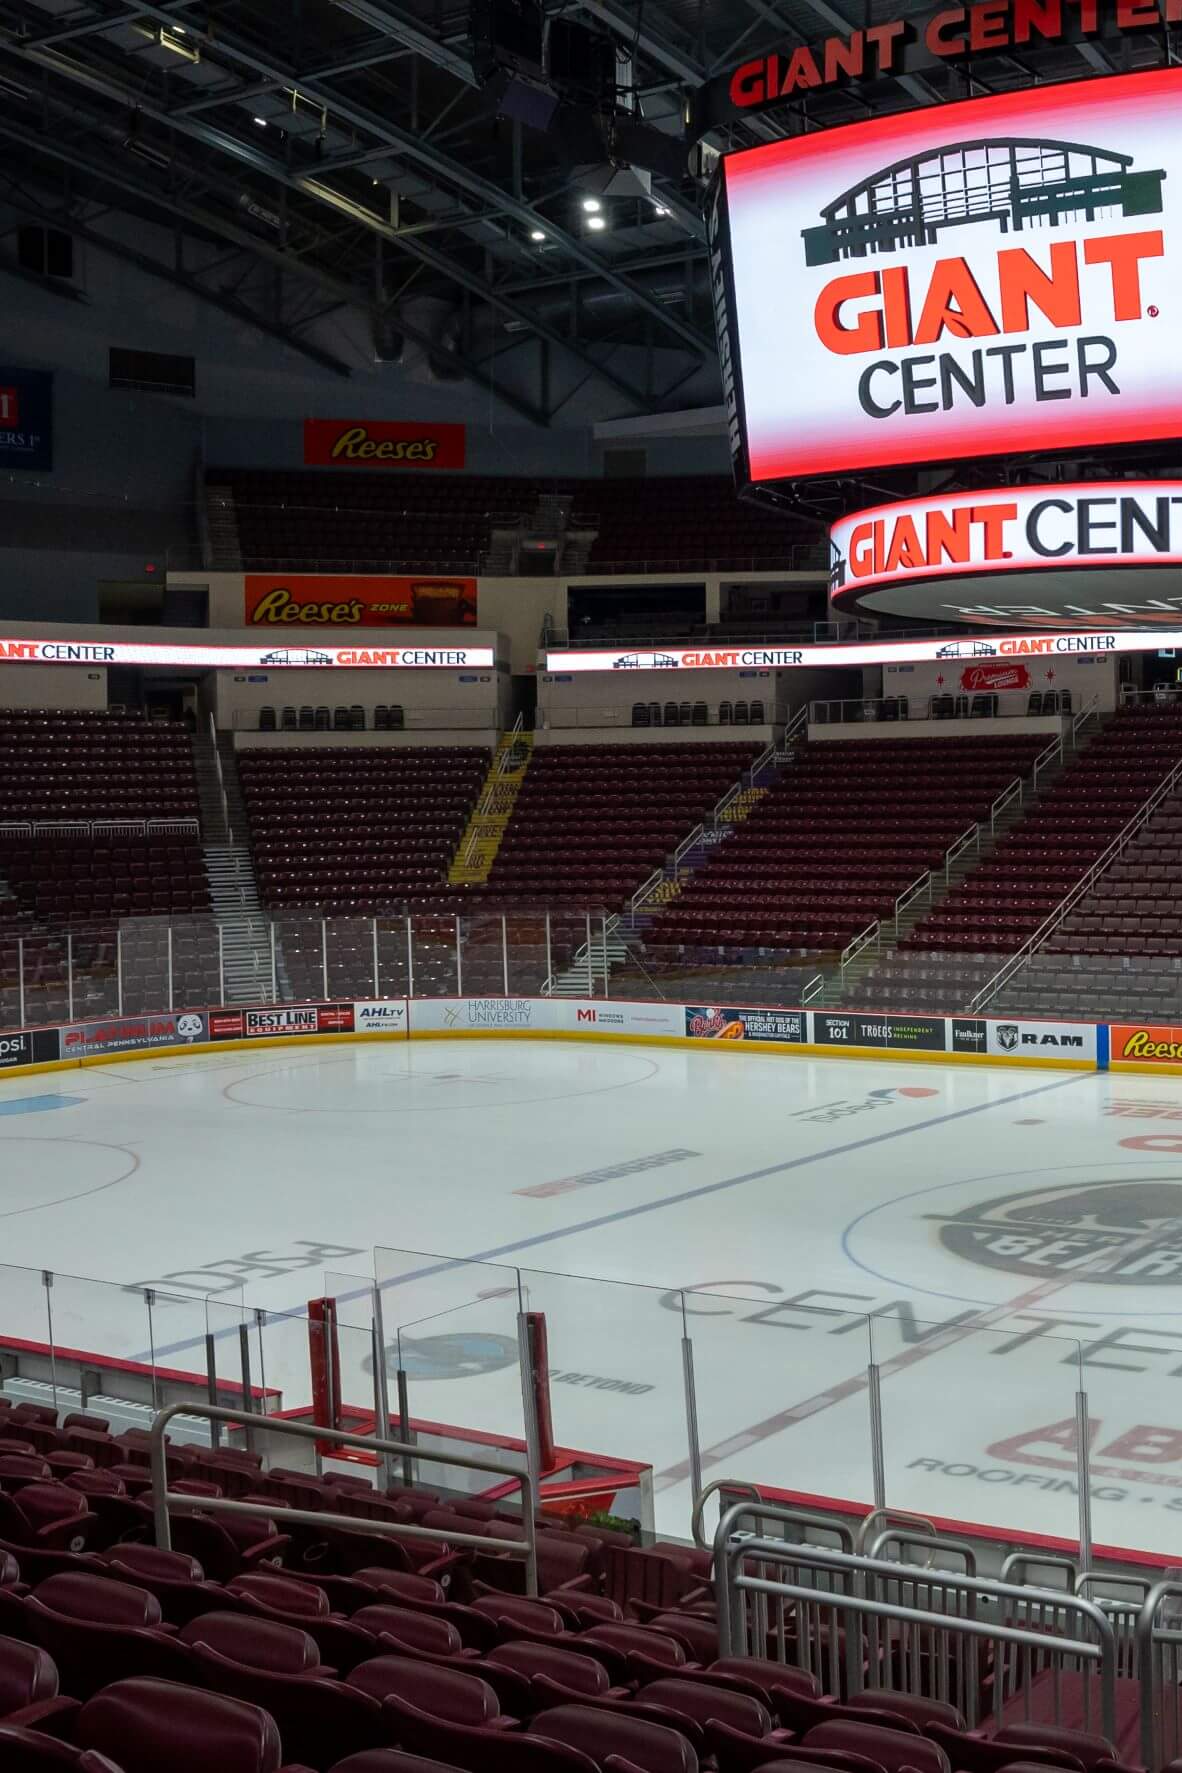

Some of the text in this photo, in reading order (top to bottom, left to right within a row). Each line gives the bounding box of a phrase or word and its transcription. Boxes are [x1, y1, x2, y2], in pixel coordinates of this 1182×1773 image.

[730, 20, 905, 107] GIANT
[814, 230, 1164, 355] GIANT
[858, 336, 1121, 419] CENTER
[331, 427, 438, 460] Reese's
[849, 504, 1018, 577] GIANT
[253, 589, 408, 623] Reese's ZONE
[42, 644, 115, 661] CENTER
[999, 636, 1115, 655] GIANT CENTER
[337, 651, 467, 666] GIANT CENTER
[681, 651, 803, 666] GIANT CENTER
[468, 1000, 531, 1012] HARRISBURG
[249, 1012, 283, 1027] BEST
[286, 1010, 316, 1025] LINE
[468, 1011, 531, 1023] UNIVERSITY
[577, 1009, 596, 1022] MI
[250, 1024, 316, 1033] EQUIPMENT
[745, 1021, 800, 1034] HERSHEY BEARS
[829, 1028, 848, 1039] 101
[66, 1035, 175, 1053] CENTRAL PENNSYLVANIA
[1021, 1032, 1083, 1047] RAM
[551, 1372, 656, 1395] BEYOND
[907, 1456, 1129, 1503] ROOFING
